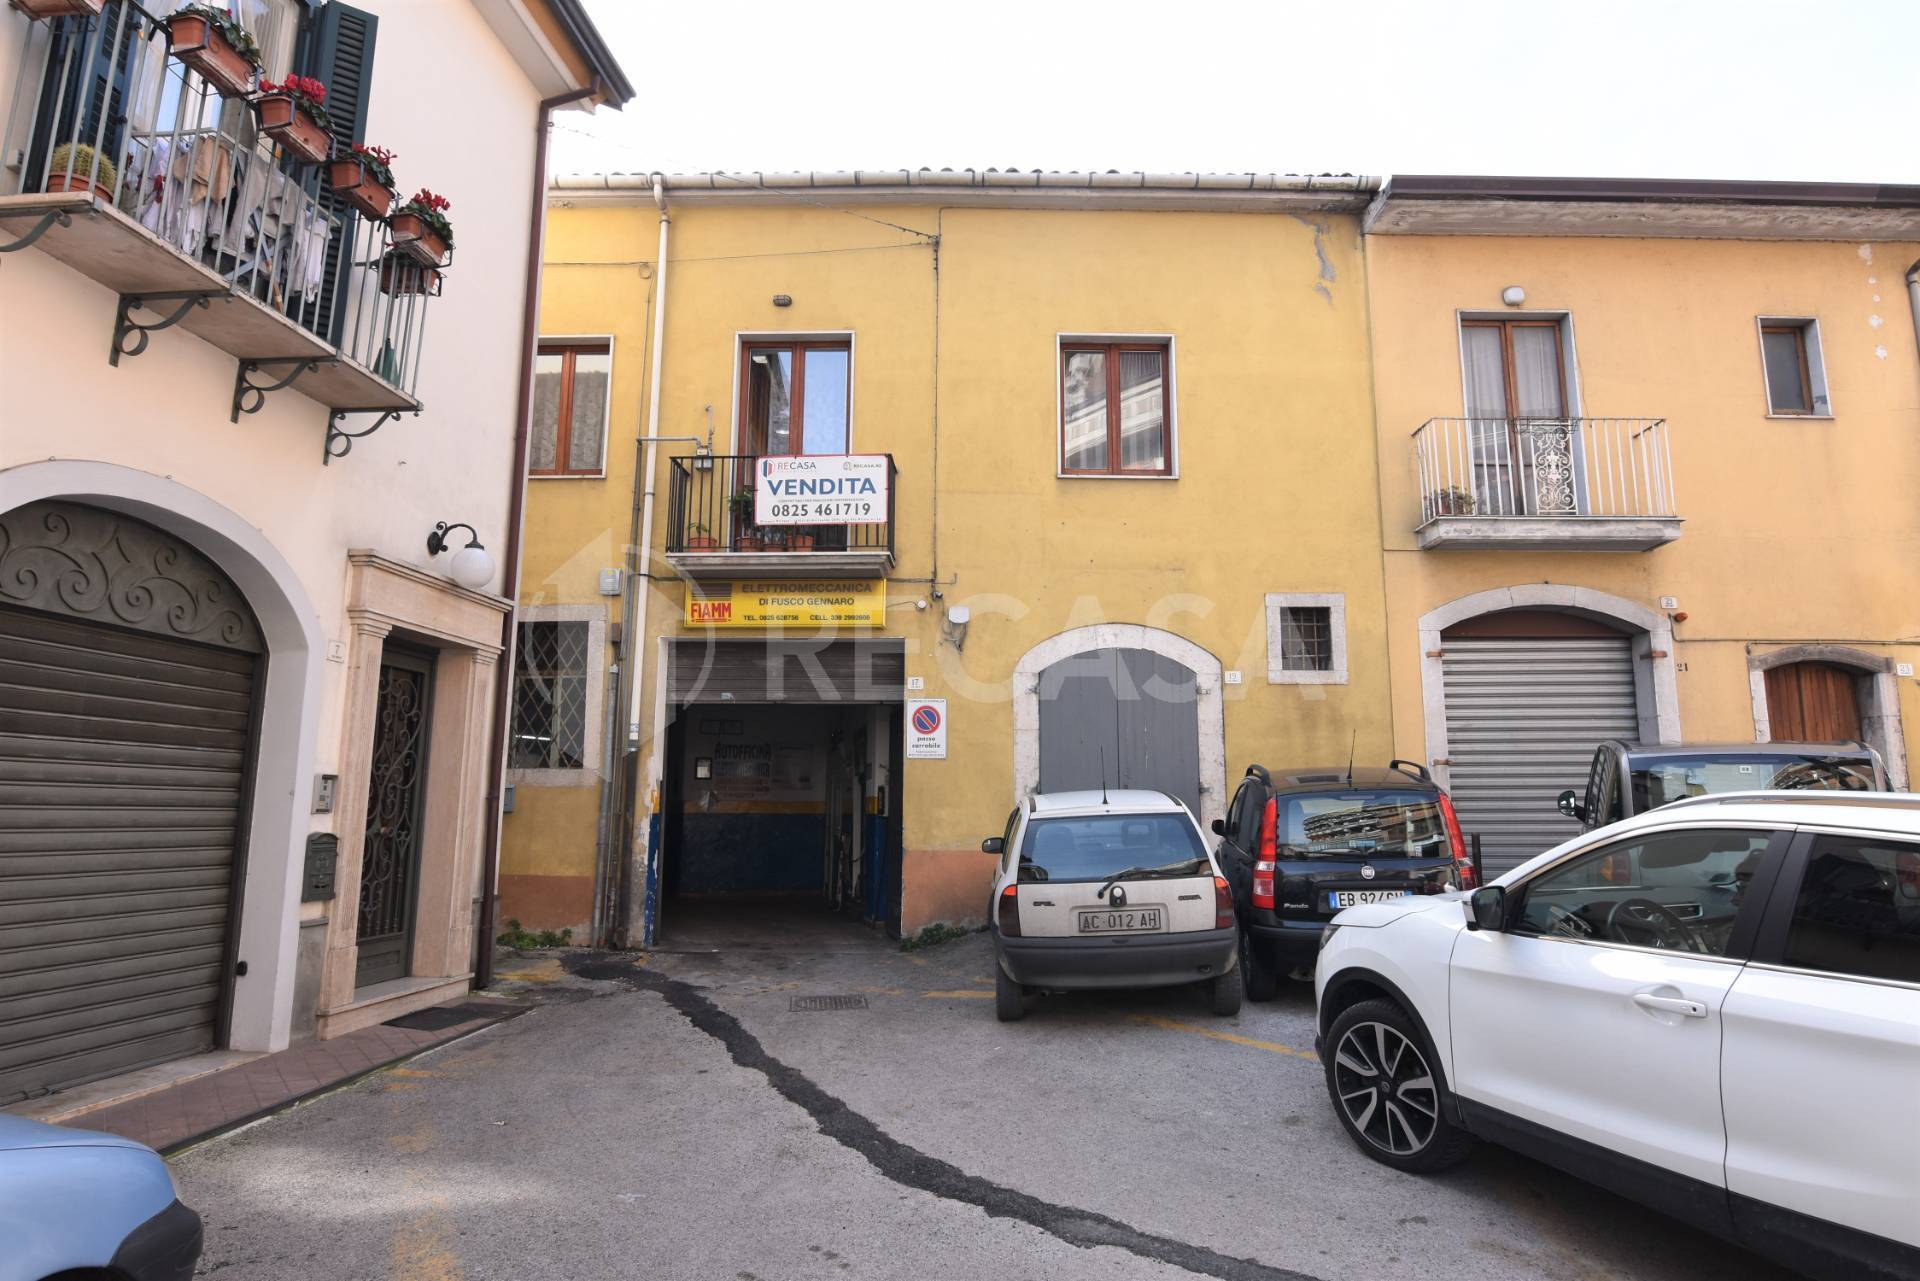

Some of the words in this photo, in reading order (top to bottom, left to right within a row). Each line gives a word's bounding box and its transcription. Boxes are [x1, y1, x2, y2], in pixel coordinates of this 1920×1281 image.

[777, 461, 817, 470] RECASA
[767, 477, 877, 496] VENDITA
[771, 504, 809, 517] 0825
[814, 502, 871, 516] 461719
[742, 583, 873, 593] ELETTROMECCANICA
[759, 598, 769, 606] DI
[771, 597, 804, 606] FUSCO
[806, 597, 855, 605] GENNARO
[690, 602, 732, 619] FIAMM
[1338, 892, 1356, 907] EB
[1083, 915, 1100, 929] AC
[1107, 913, 1134, 928] 012
[1140, 912, 1157, 927] AH
